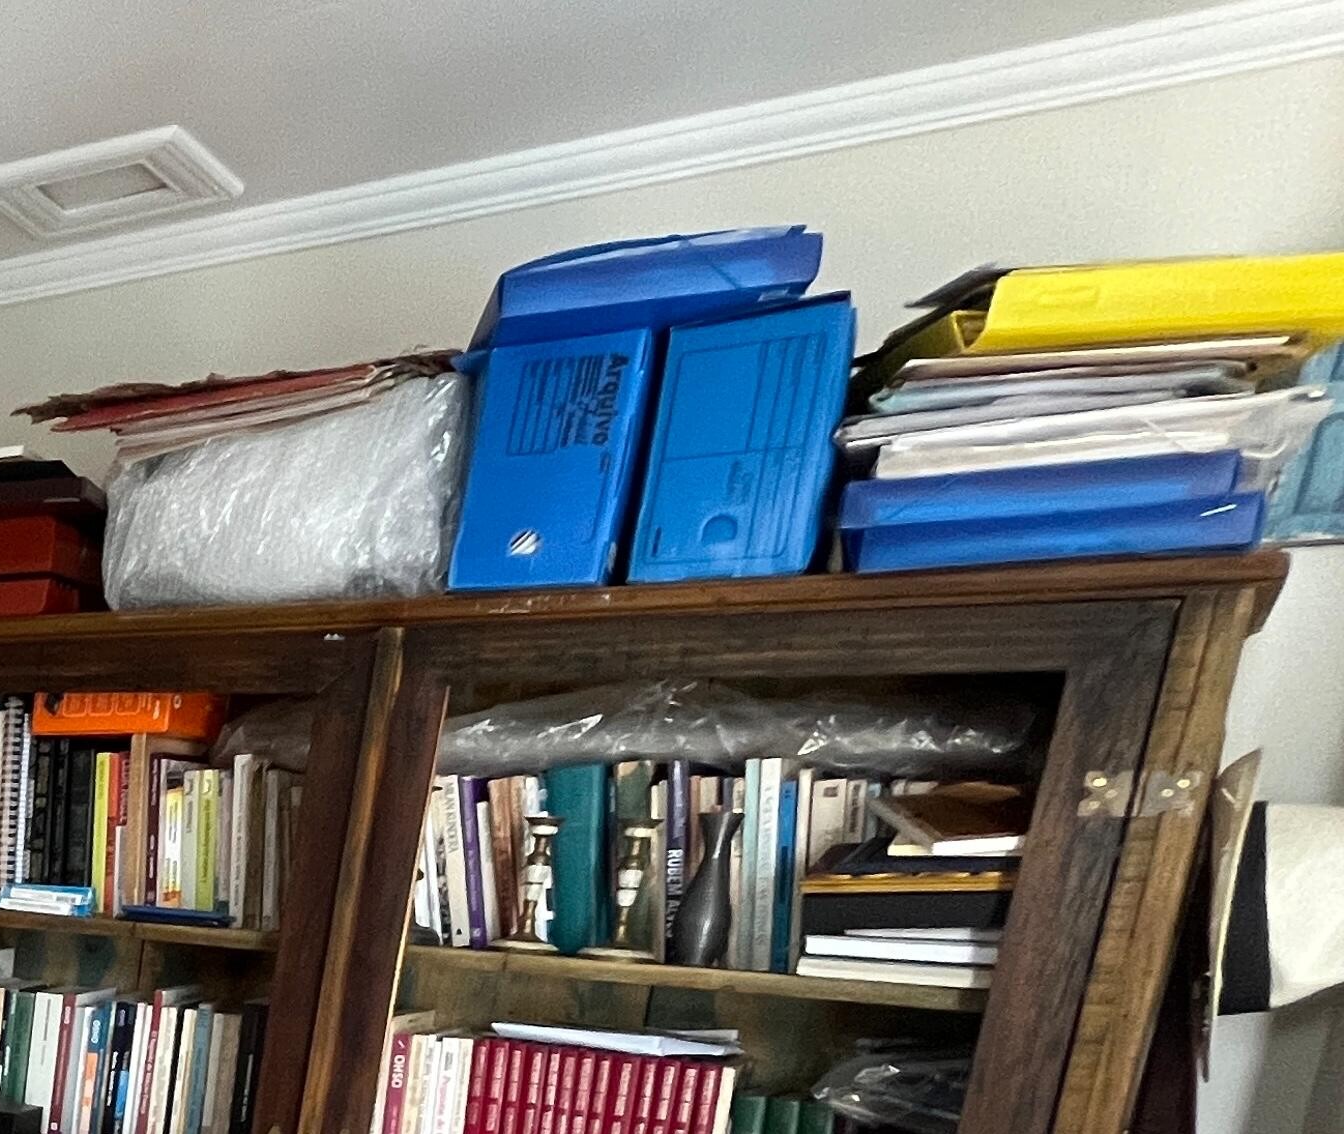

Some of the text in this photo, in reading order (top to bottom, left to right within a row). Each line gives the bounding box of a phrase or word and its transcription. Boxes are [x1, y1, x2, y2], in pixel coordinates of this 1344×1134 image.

[592, 352, 629, 446] Arquivo
[667, 849, 684, 895] RUBEM
[391, 1054, 406, 1088] OSHO
